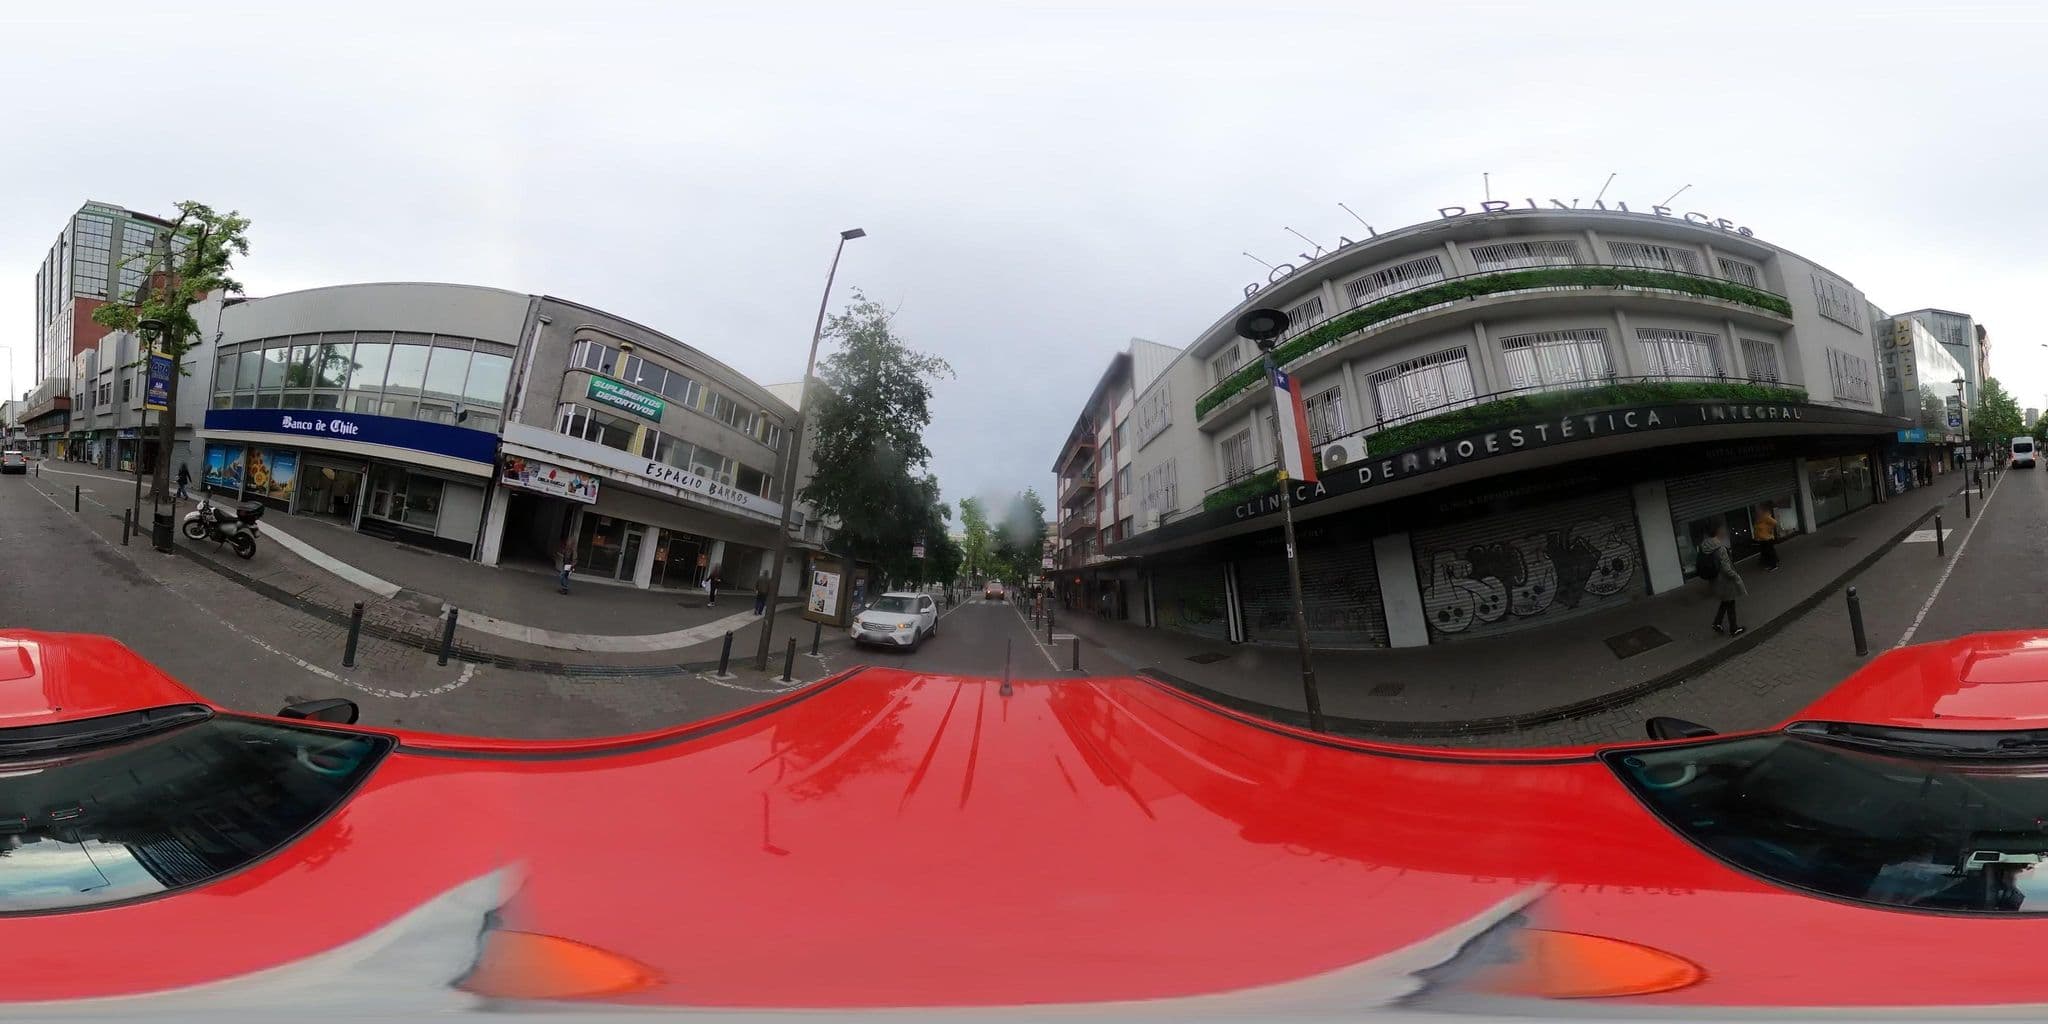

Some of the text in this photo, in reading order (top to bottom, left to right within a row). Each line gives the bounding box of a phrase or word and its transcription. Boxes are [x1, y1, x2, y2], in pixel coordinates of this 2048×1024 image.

[593, 380, 662, 408] SUPLEMENTOS
[596, 390, 656, 416] DEPORTIVOS
[282, 415, 359, 435] Banco de Chile
[1236, 406, 1801, 519] CLÍNCA DERMOESTÉTICA INTEGRAL
[646, 463, 748, 505] ESPACIO BARROS
